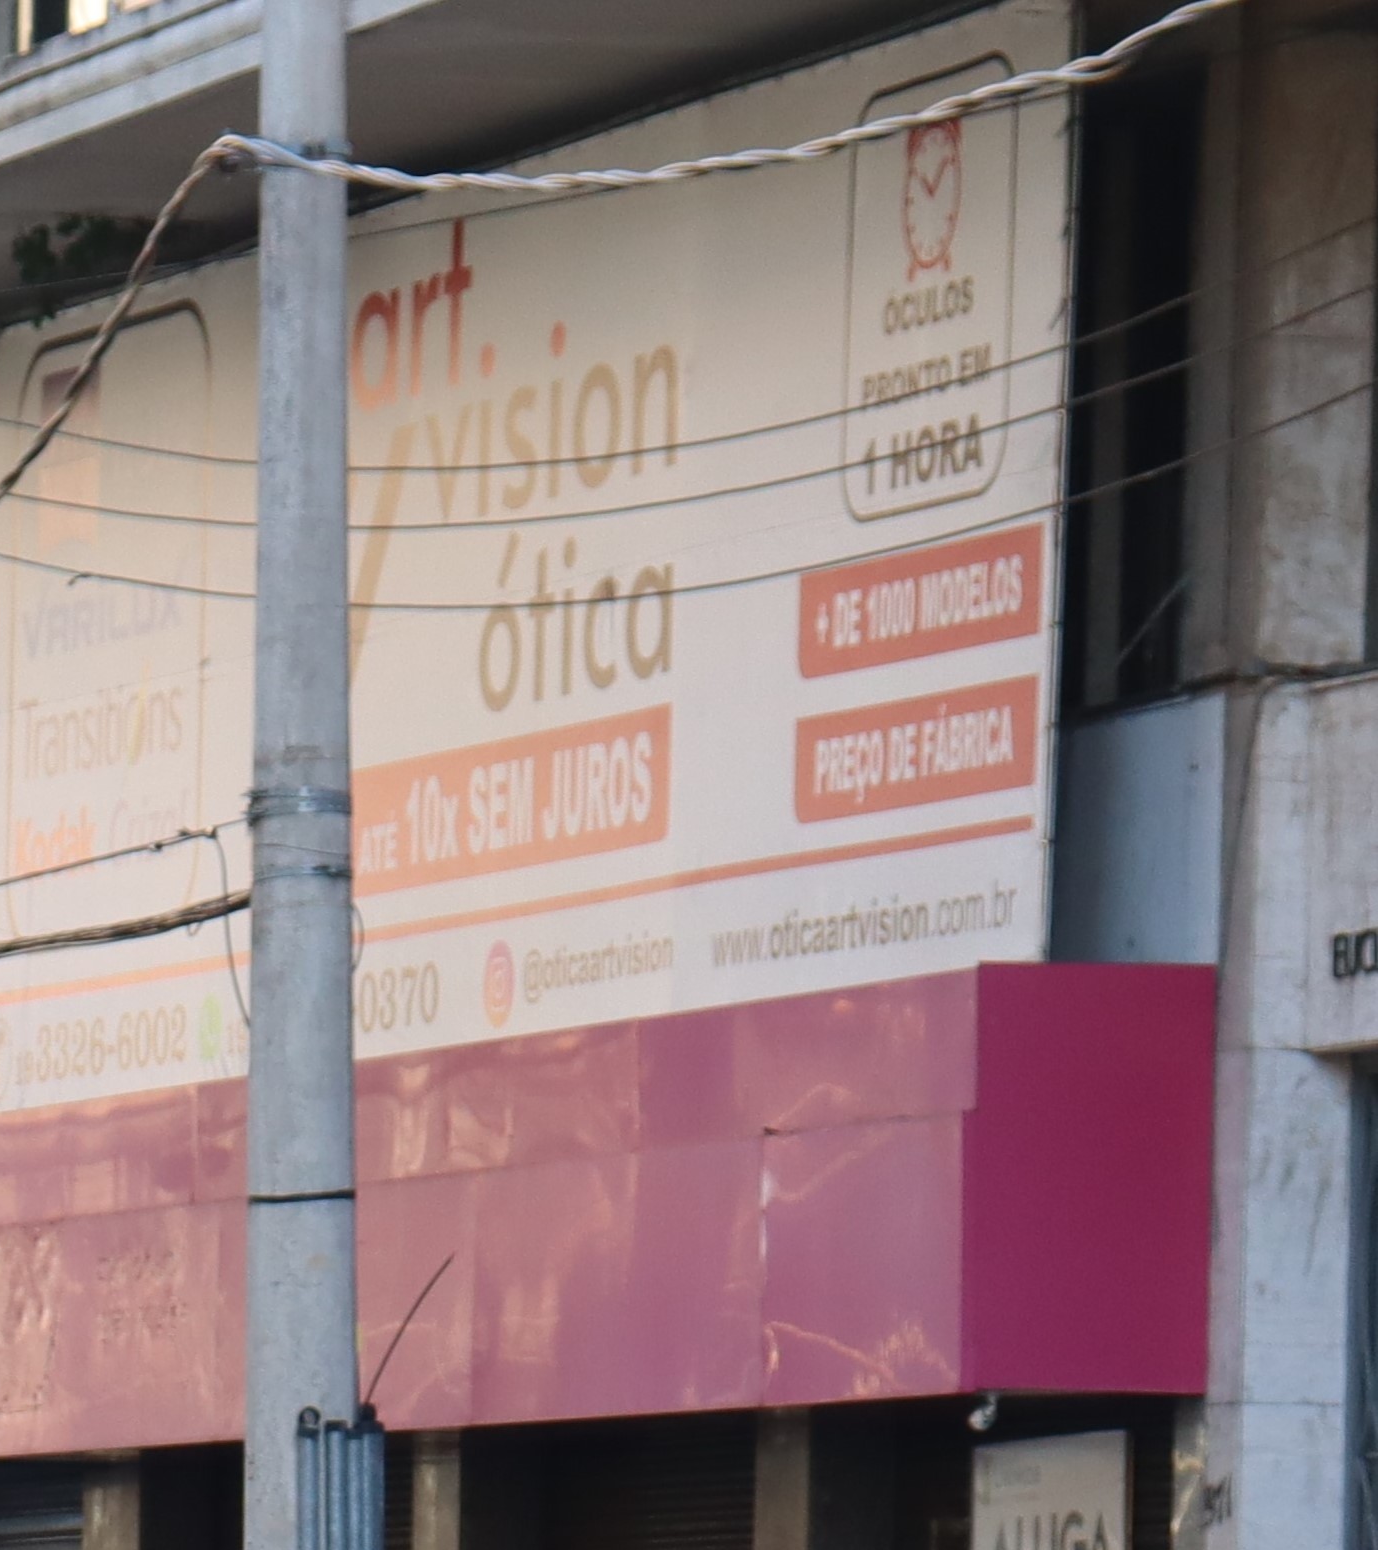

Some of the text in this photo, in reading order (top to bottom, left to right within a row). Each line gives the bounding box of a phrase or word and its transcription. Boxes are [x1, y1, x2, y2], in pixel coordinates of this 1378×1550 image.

[350, 216, 473, 412] art
[883, 274, 974, 336] ÓCULOS
[423, 320, 680, 522] vision
[861, 343, 992, 410] PRONTO EM
[864, 412, 982, 494] 1 HORA
[478, 531, 675, 712] ótica
[832, 588, 863, 648] DE
[867, 577, 915, 641] 1000
[918, 554, 1022, 630] MODELOS
[406, 775, 460, 865] 10x
[467, 756, 535, 856] SEM
[543, 731, 653, 841] JUROS
[814, 703, 1014, 804] PREÇO DE FÁBRICA
